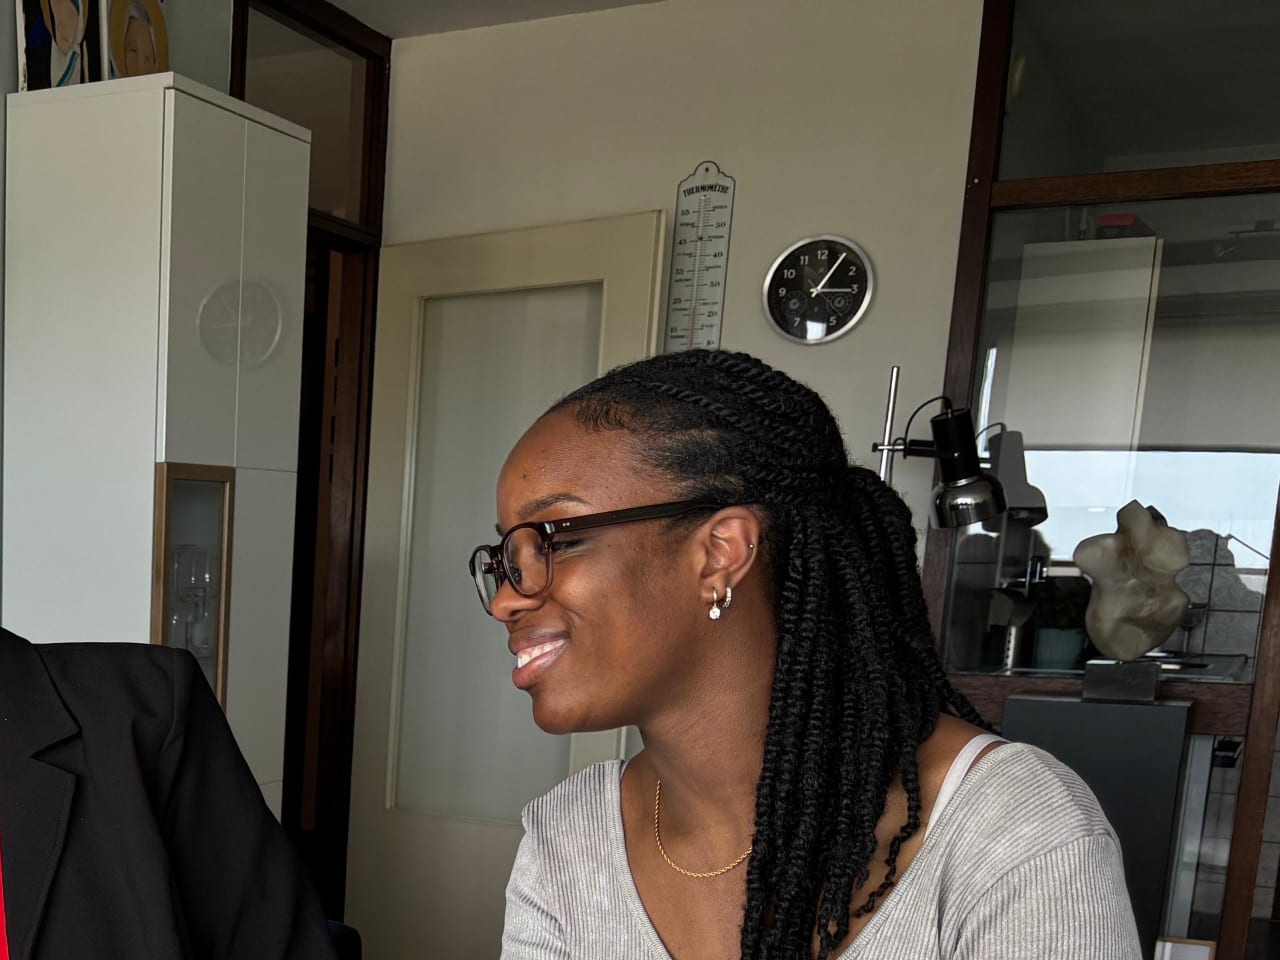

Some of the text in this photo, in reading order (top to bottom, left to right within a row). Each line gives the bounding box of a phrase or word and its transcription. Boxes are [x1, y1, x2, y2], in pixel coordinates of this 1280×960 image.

[800, 255, 809, 265] 11
[817, 250, 828, 260] 12
[783, 269, 796, 279] 10
[848, 266, 857, 276] 2
[778, 287, 786, 297] 9
[851, 284, 858, 294] 3
[794, 317, 801, 327] 7
[829, 316, 837, 326] 5
